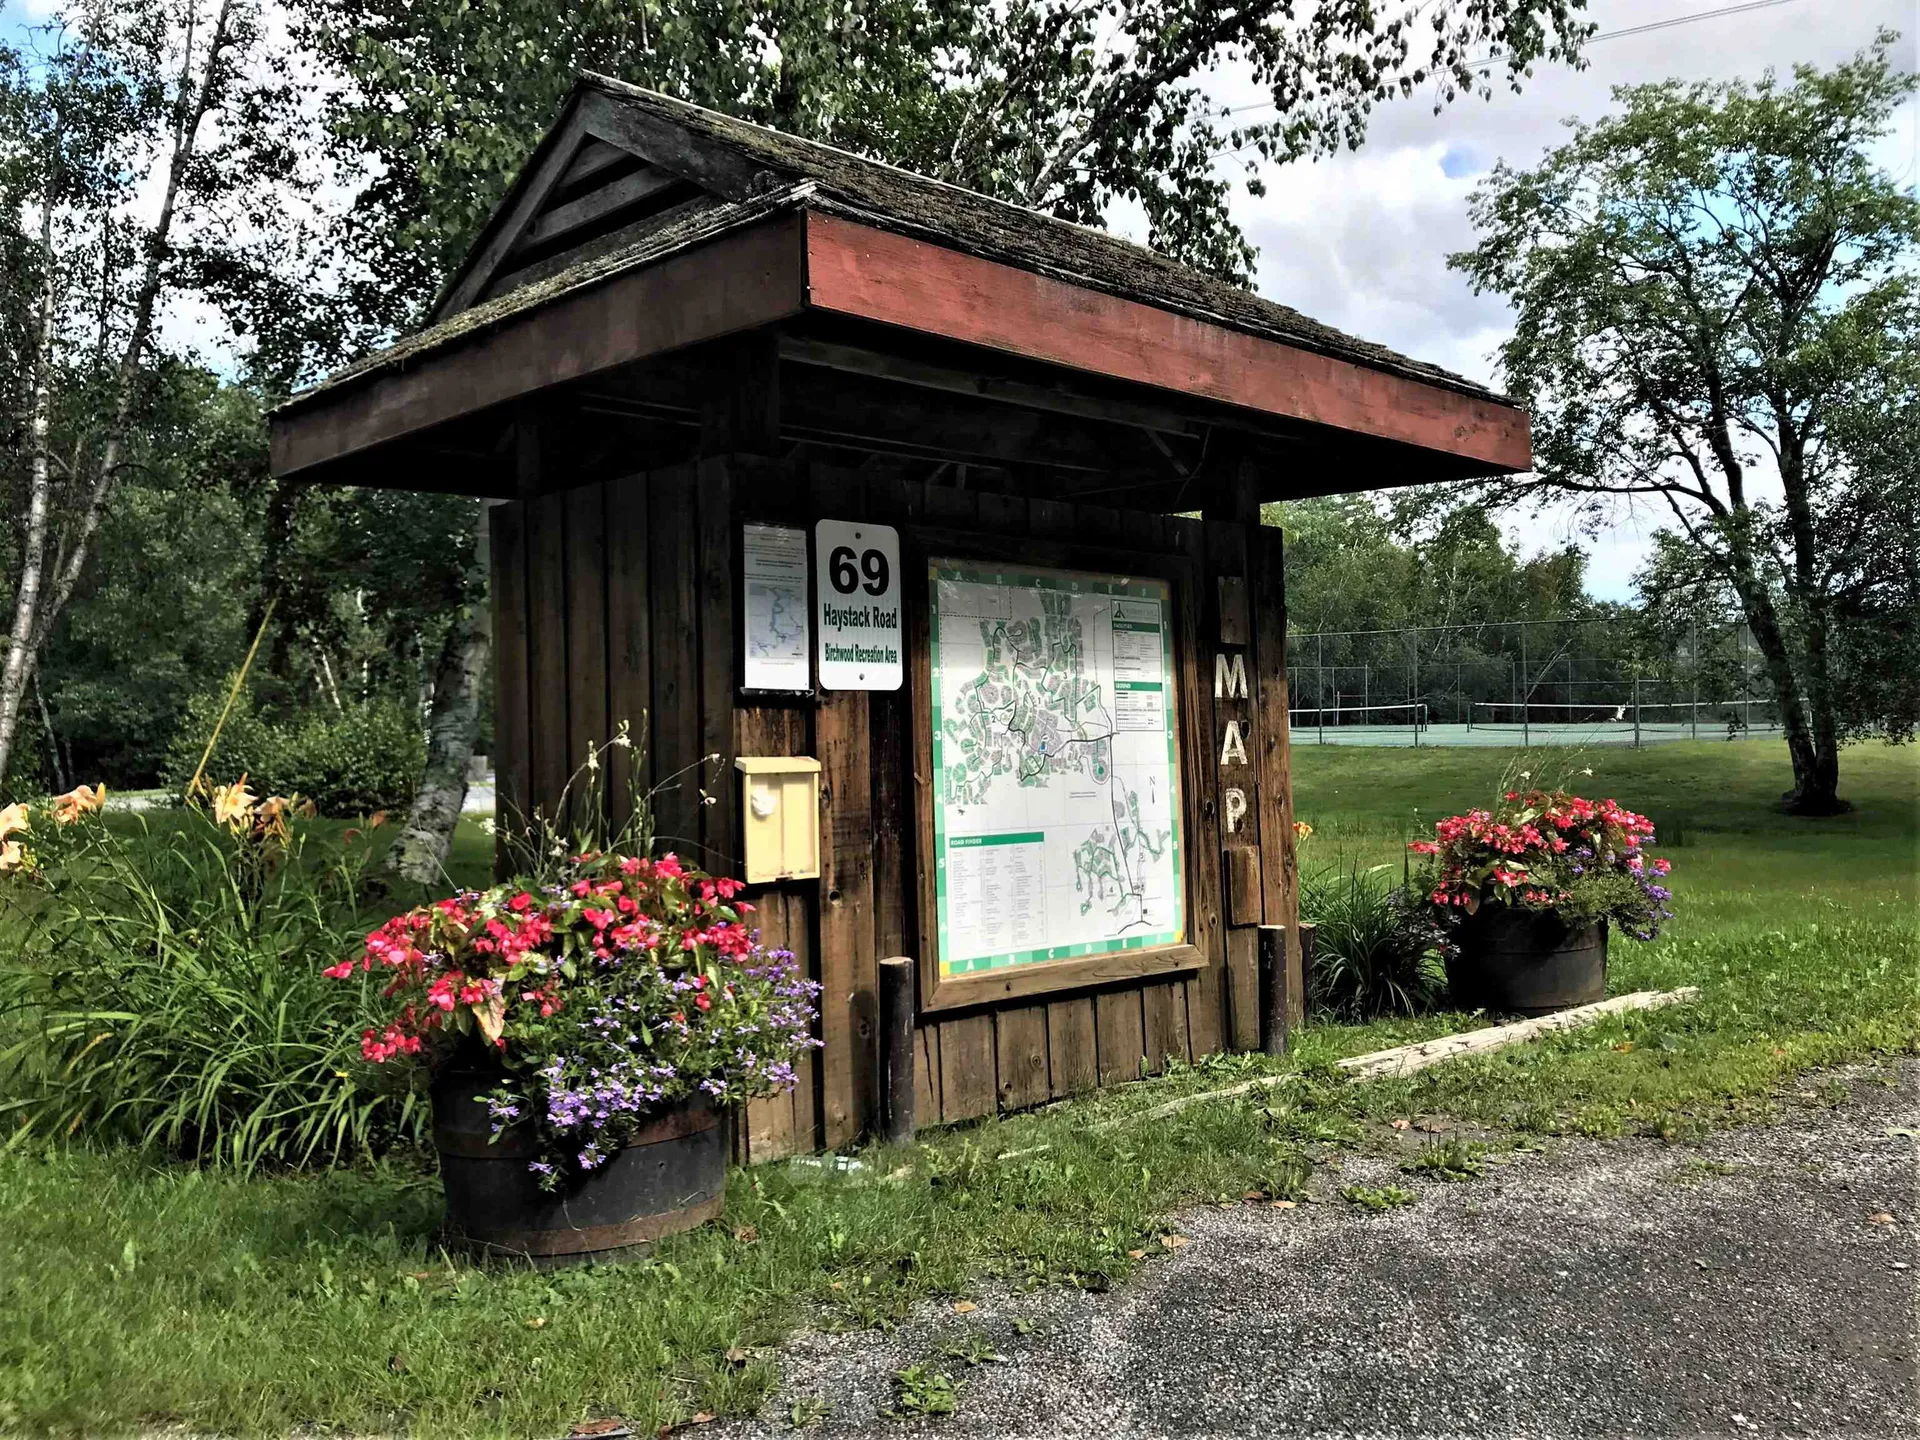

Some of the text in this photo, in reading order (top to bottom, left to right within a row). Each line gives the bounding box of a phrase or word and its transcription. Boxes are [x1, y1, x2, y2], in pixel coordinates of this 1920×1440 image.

[829, 546, 890, 596] 69
[823, 603, 897, 632] Haystack Road
[824, 642, 897, 664] Birchwood Recreation Area
[934, 730, 941, 740] 3
[1215, 653, 1248, 833] MAP
[1149, 776, 1156, 786] N
[938, 857, 945, 868] 5
[966, 960, 974, 970] A
[1008, 954, 1015, 964] B
[1048, 948, 1054, 958] C
[1085, 943, 1092, 954] D
